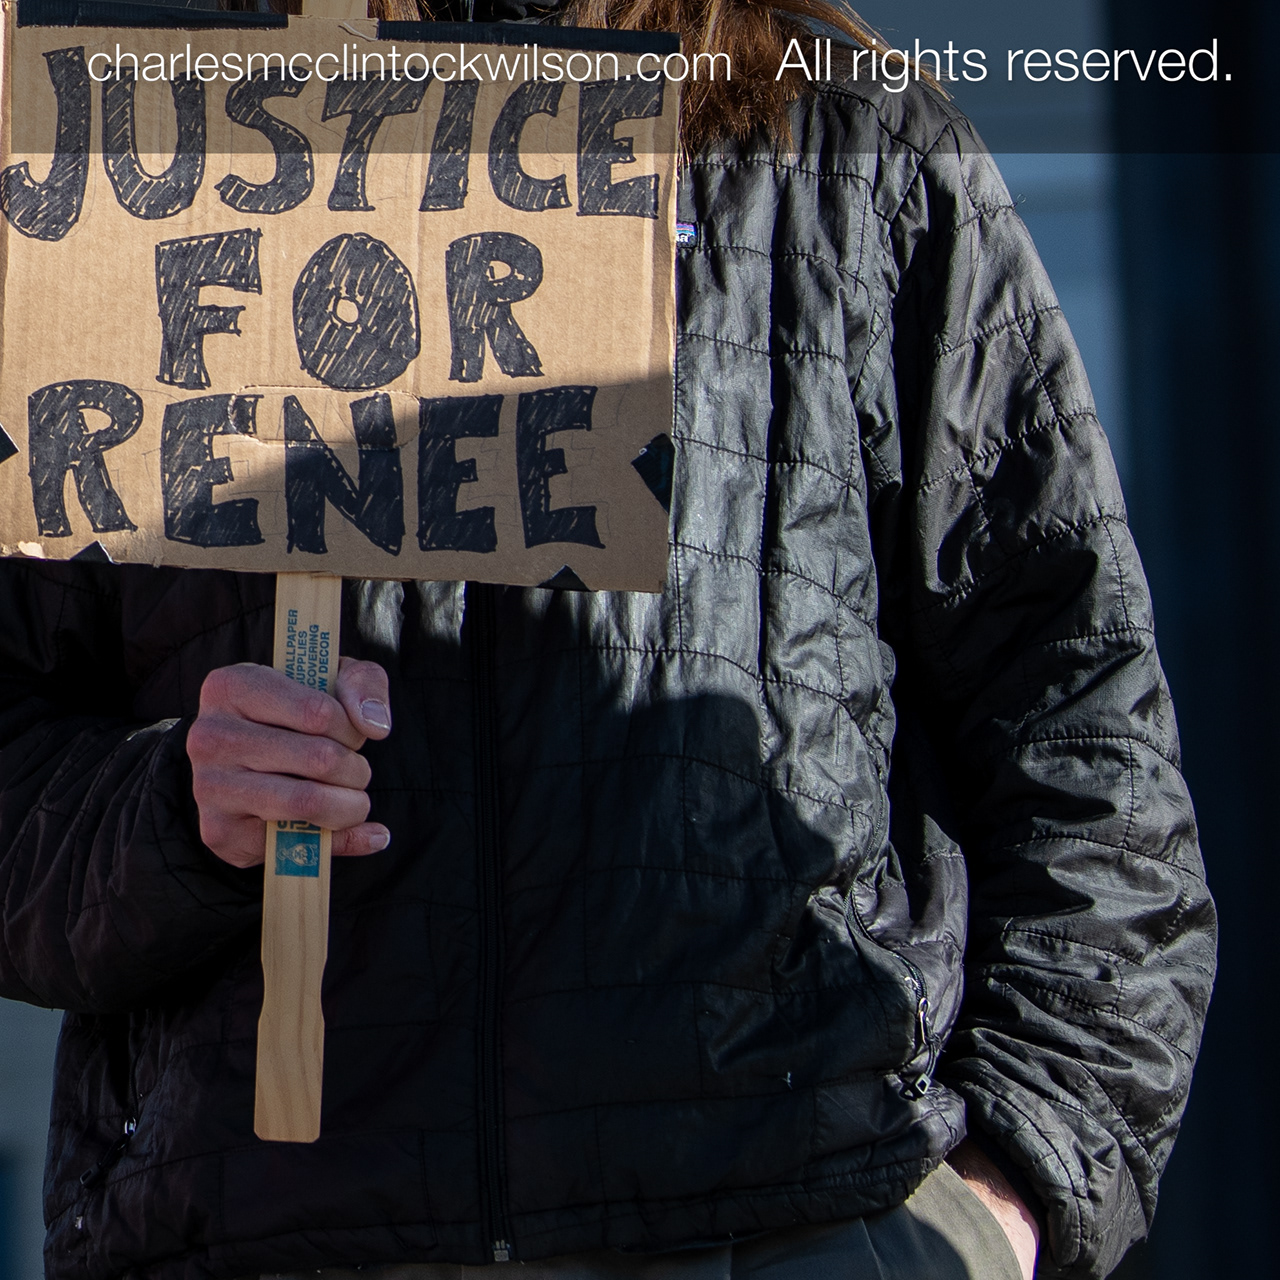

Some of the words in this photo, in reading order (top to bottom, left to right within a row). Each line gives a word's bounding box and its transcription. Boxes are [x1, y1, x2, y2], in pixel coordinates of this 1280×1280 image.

[155, 228, 545, 390] FOR
[27, 378, 606, 555] RENEE
[318, 631, 331, 674] DECOR
